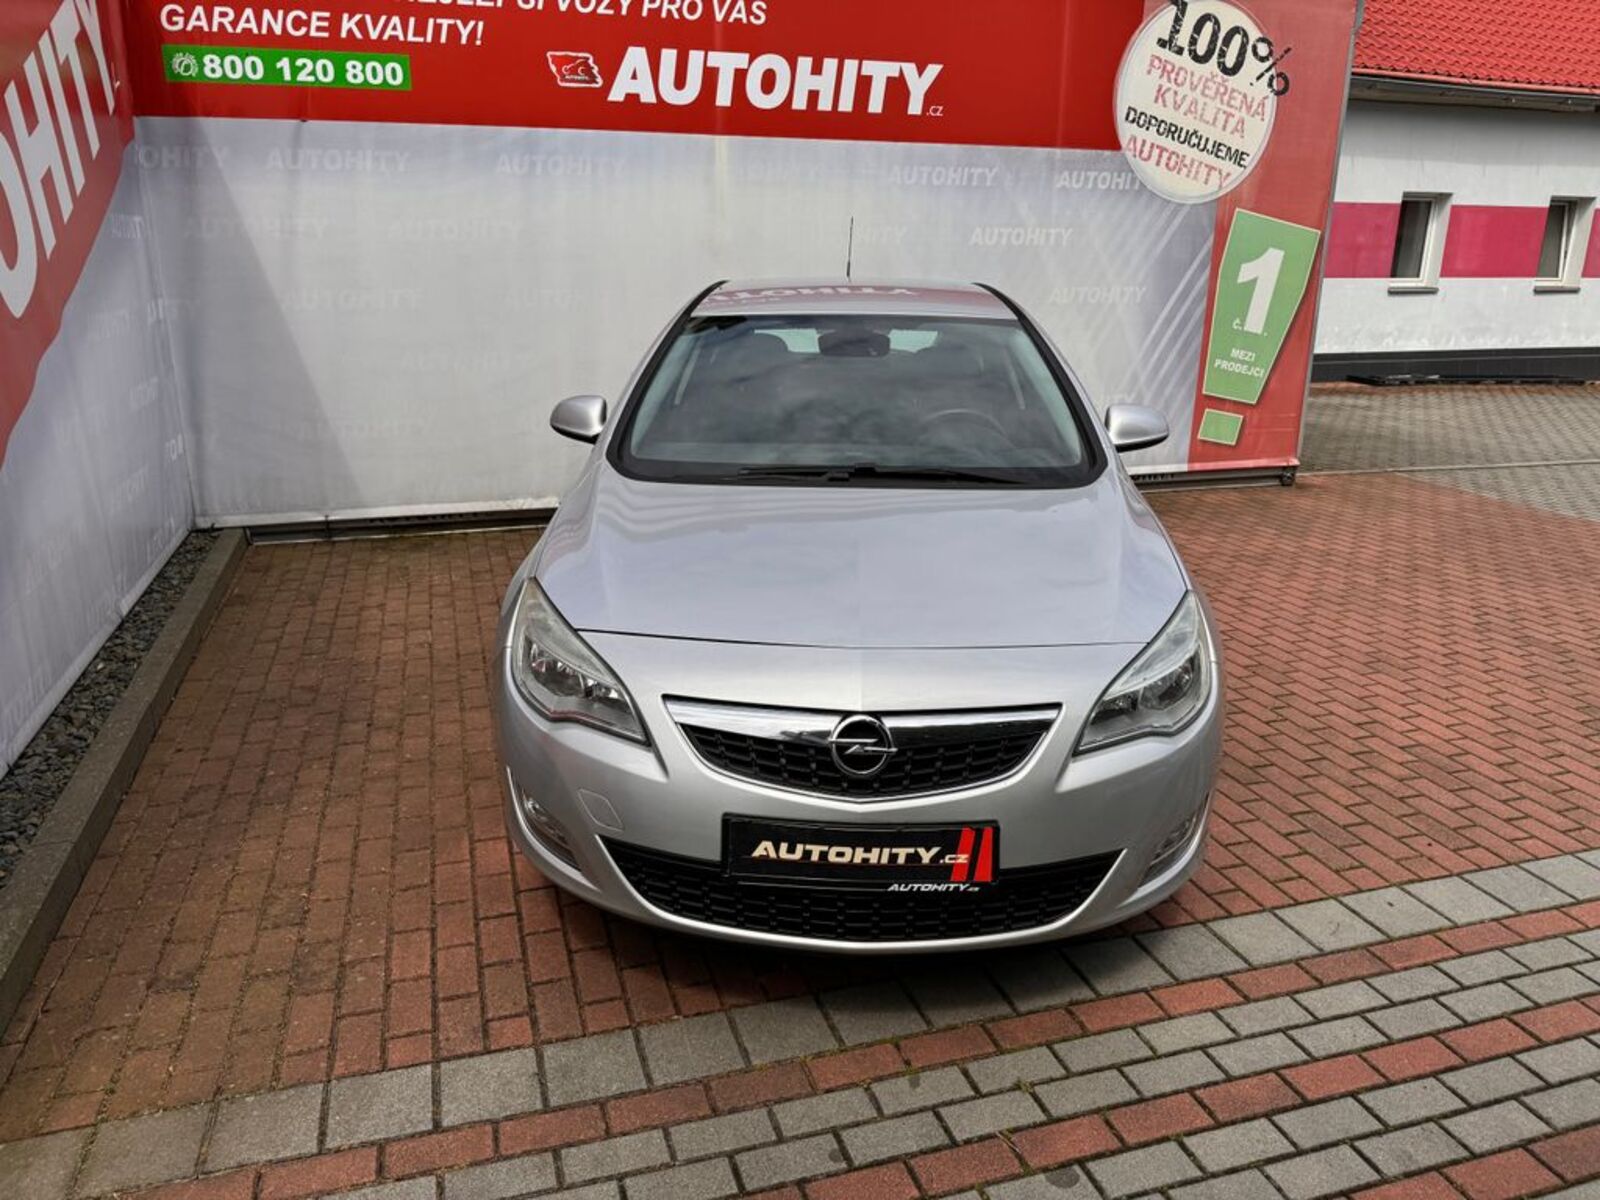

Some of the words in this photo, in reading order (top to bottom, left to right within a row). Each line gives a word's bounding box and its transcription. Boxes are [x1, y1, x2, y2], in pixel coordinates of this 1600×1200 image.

[160, 4, 330, 38] GARANCE
[339, 12, 485, 46] KVALITY!
[641, 0, 703, 21] PRO
[1156, 0, 1292, 96] 100%
[202, 54, 265, 81] 800
[276, 57, 335, 84] 120
[345, 60, 404, 86] 800
[1147, 54, 1269, 122] PROVĚŘENÁ
[1153, 84, 1246, 139] KVALITA
[1125, 106, 1250, 170] DOPORUČUJEME
[887, 165, 999, 188] AUTOHITY
[1126, 136, 1232, 191] AUTOHITY
[970, 226, 1074, 248] AUTOHITY
[1213, 359, 1265, 378] PRODEJCI
[1230, 348, 1256, 362] MEZI
